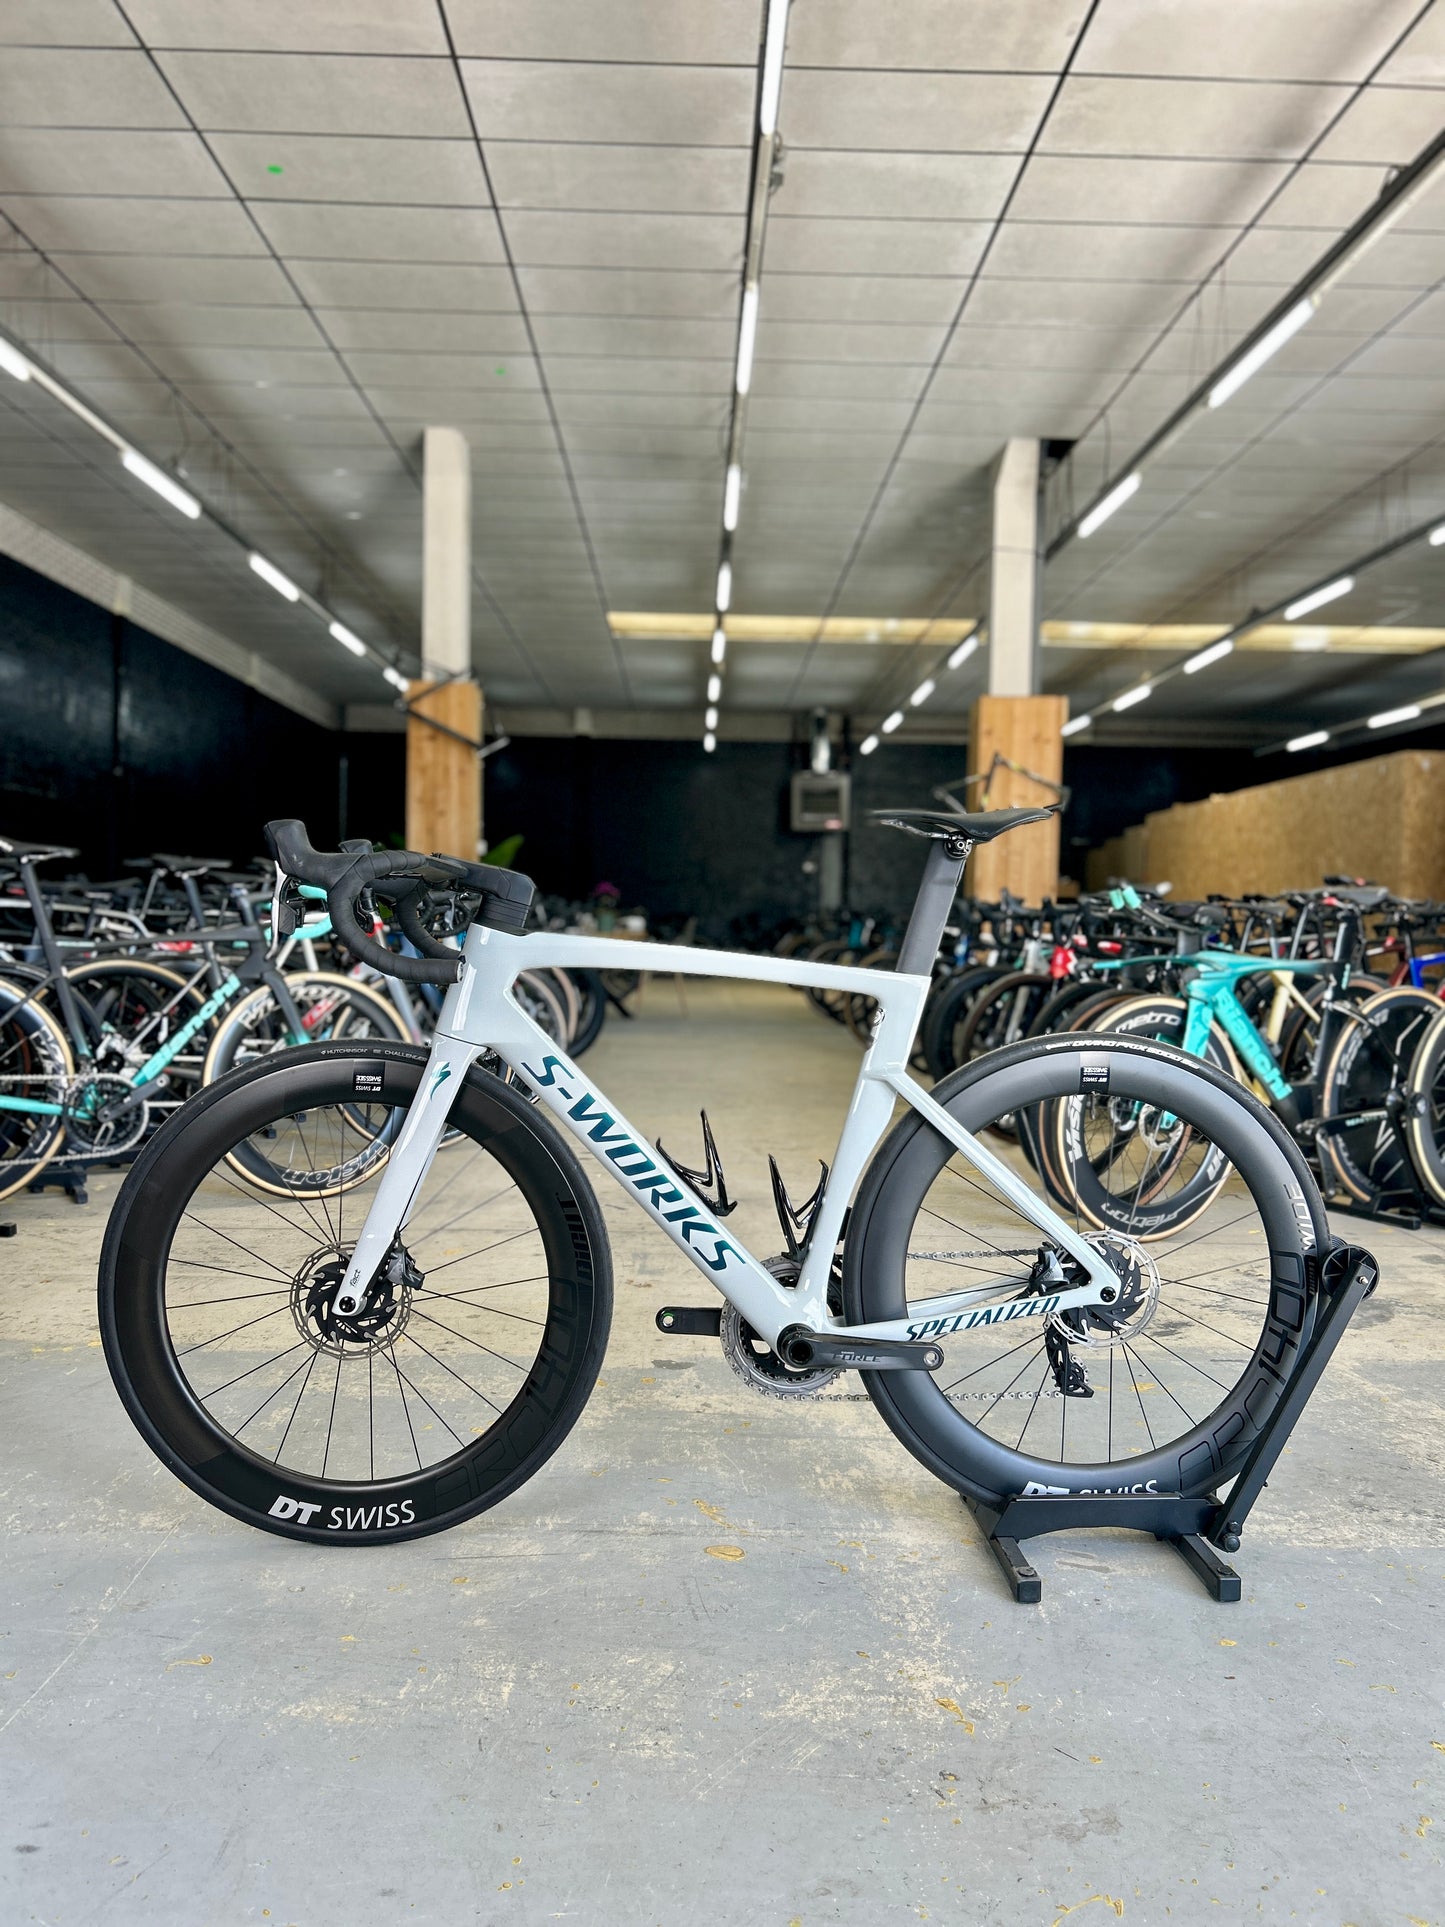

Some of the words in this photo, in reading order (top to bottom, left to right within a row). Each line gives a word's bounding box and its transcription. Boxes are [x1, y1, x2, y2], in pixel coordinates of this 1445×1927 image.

[1116, 1011, 1181, 1033] metro
[520, 1055, 746, 1272] S-WORKS
[906, 1295, 1061, 1341] SPECIALIZED
[832, 1352, 882, 1363] FORCE
[267, 1494, 323, 1525] DT
[327, 1499, 416, 1530] SWISS
